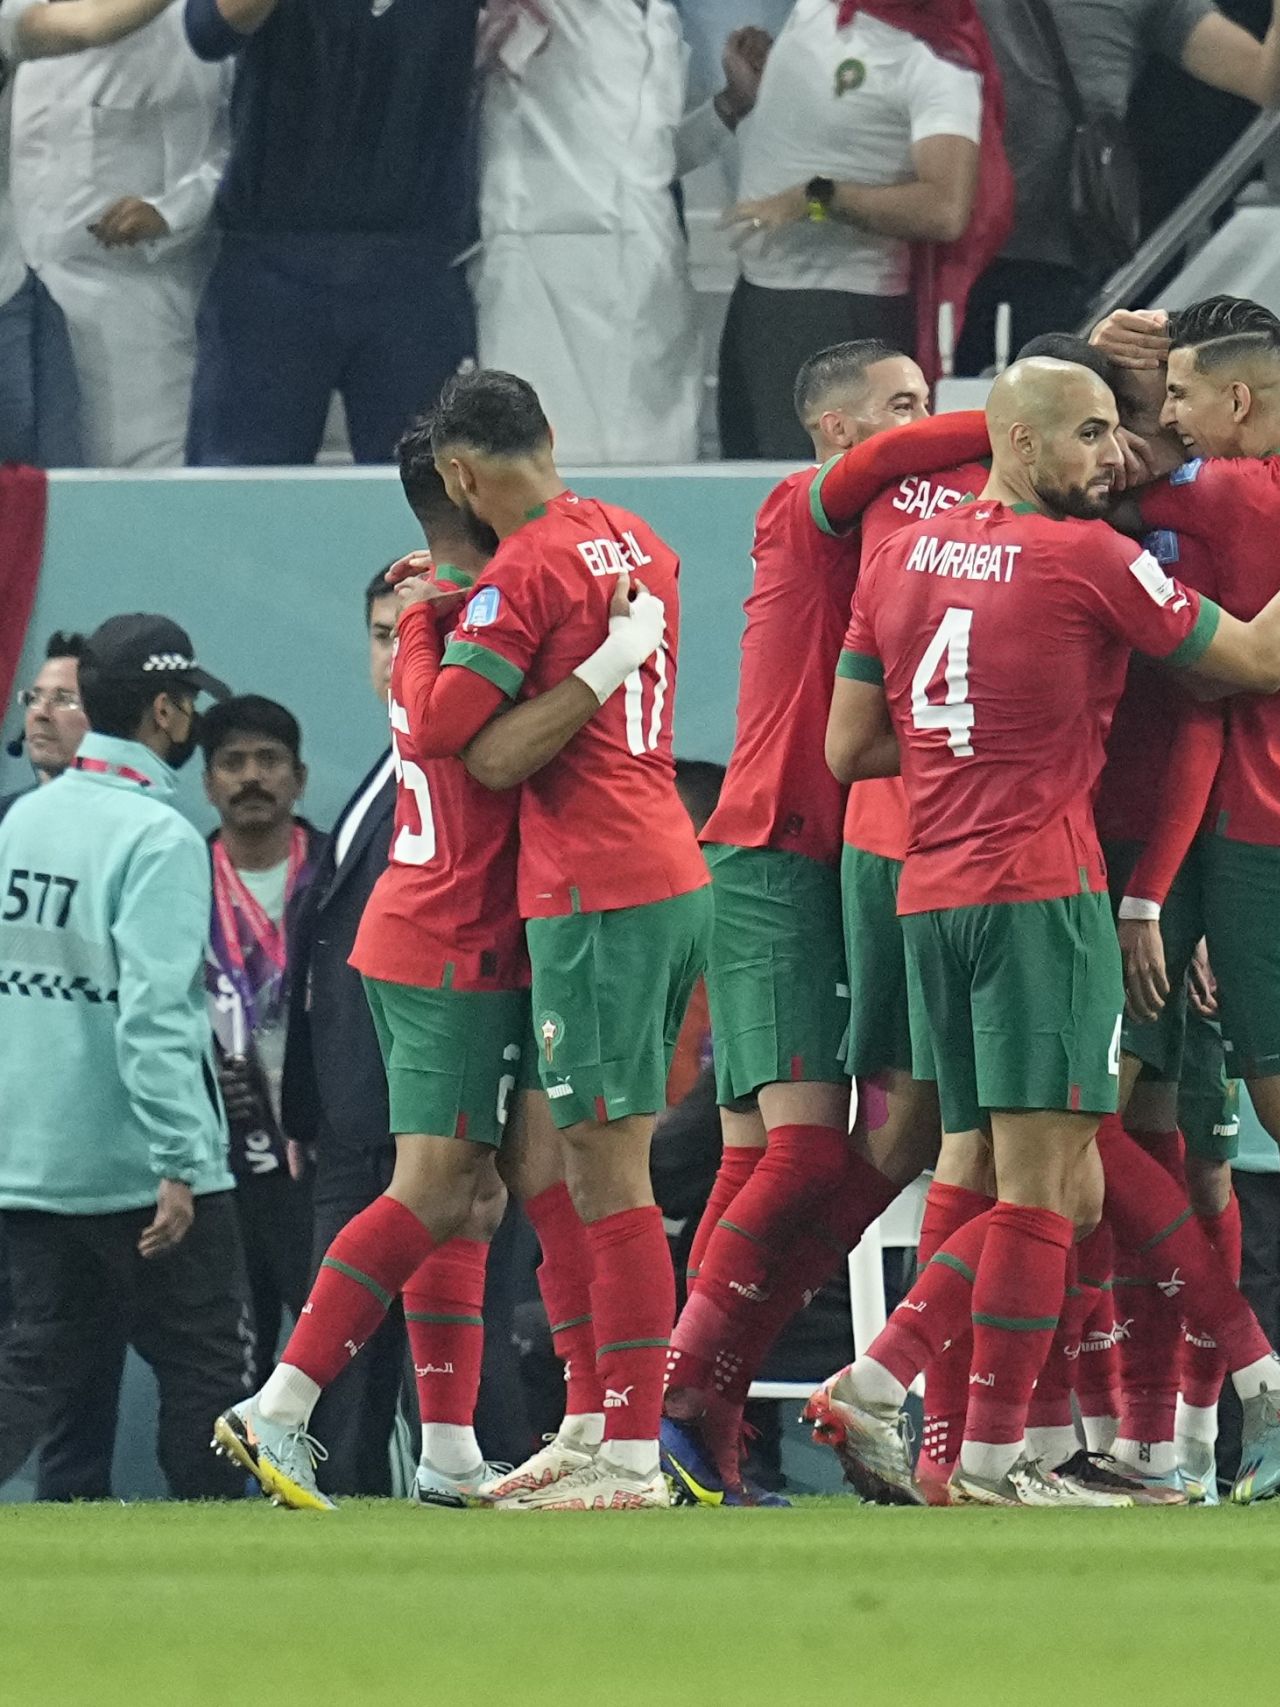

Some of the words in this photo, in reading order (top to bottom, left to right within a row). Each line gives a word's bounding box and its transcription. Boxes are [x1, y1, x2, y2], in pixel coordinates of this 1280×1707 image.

[906, 535, 1022, 583] AMRABAT
[911, 607, 975, 757] 4
[3, 869, 79, 928] 577
